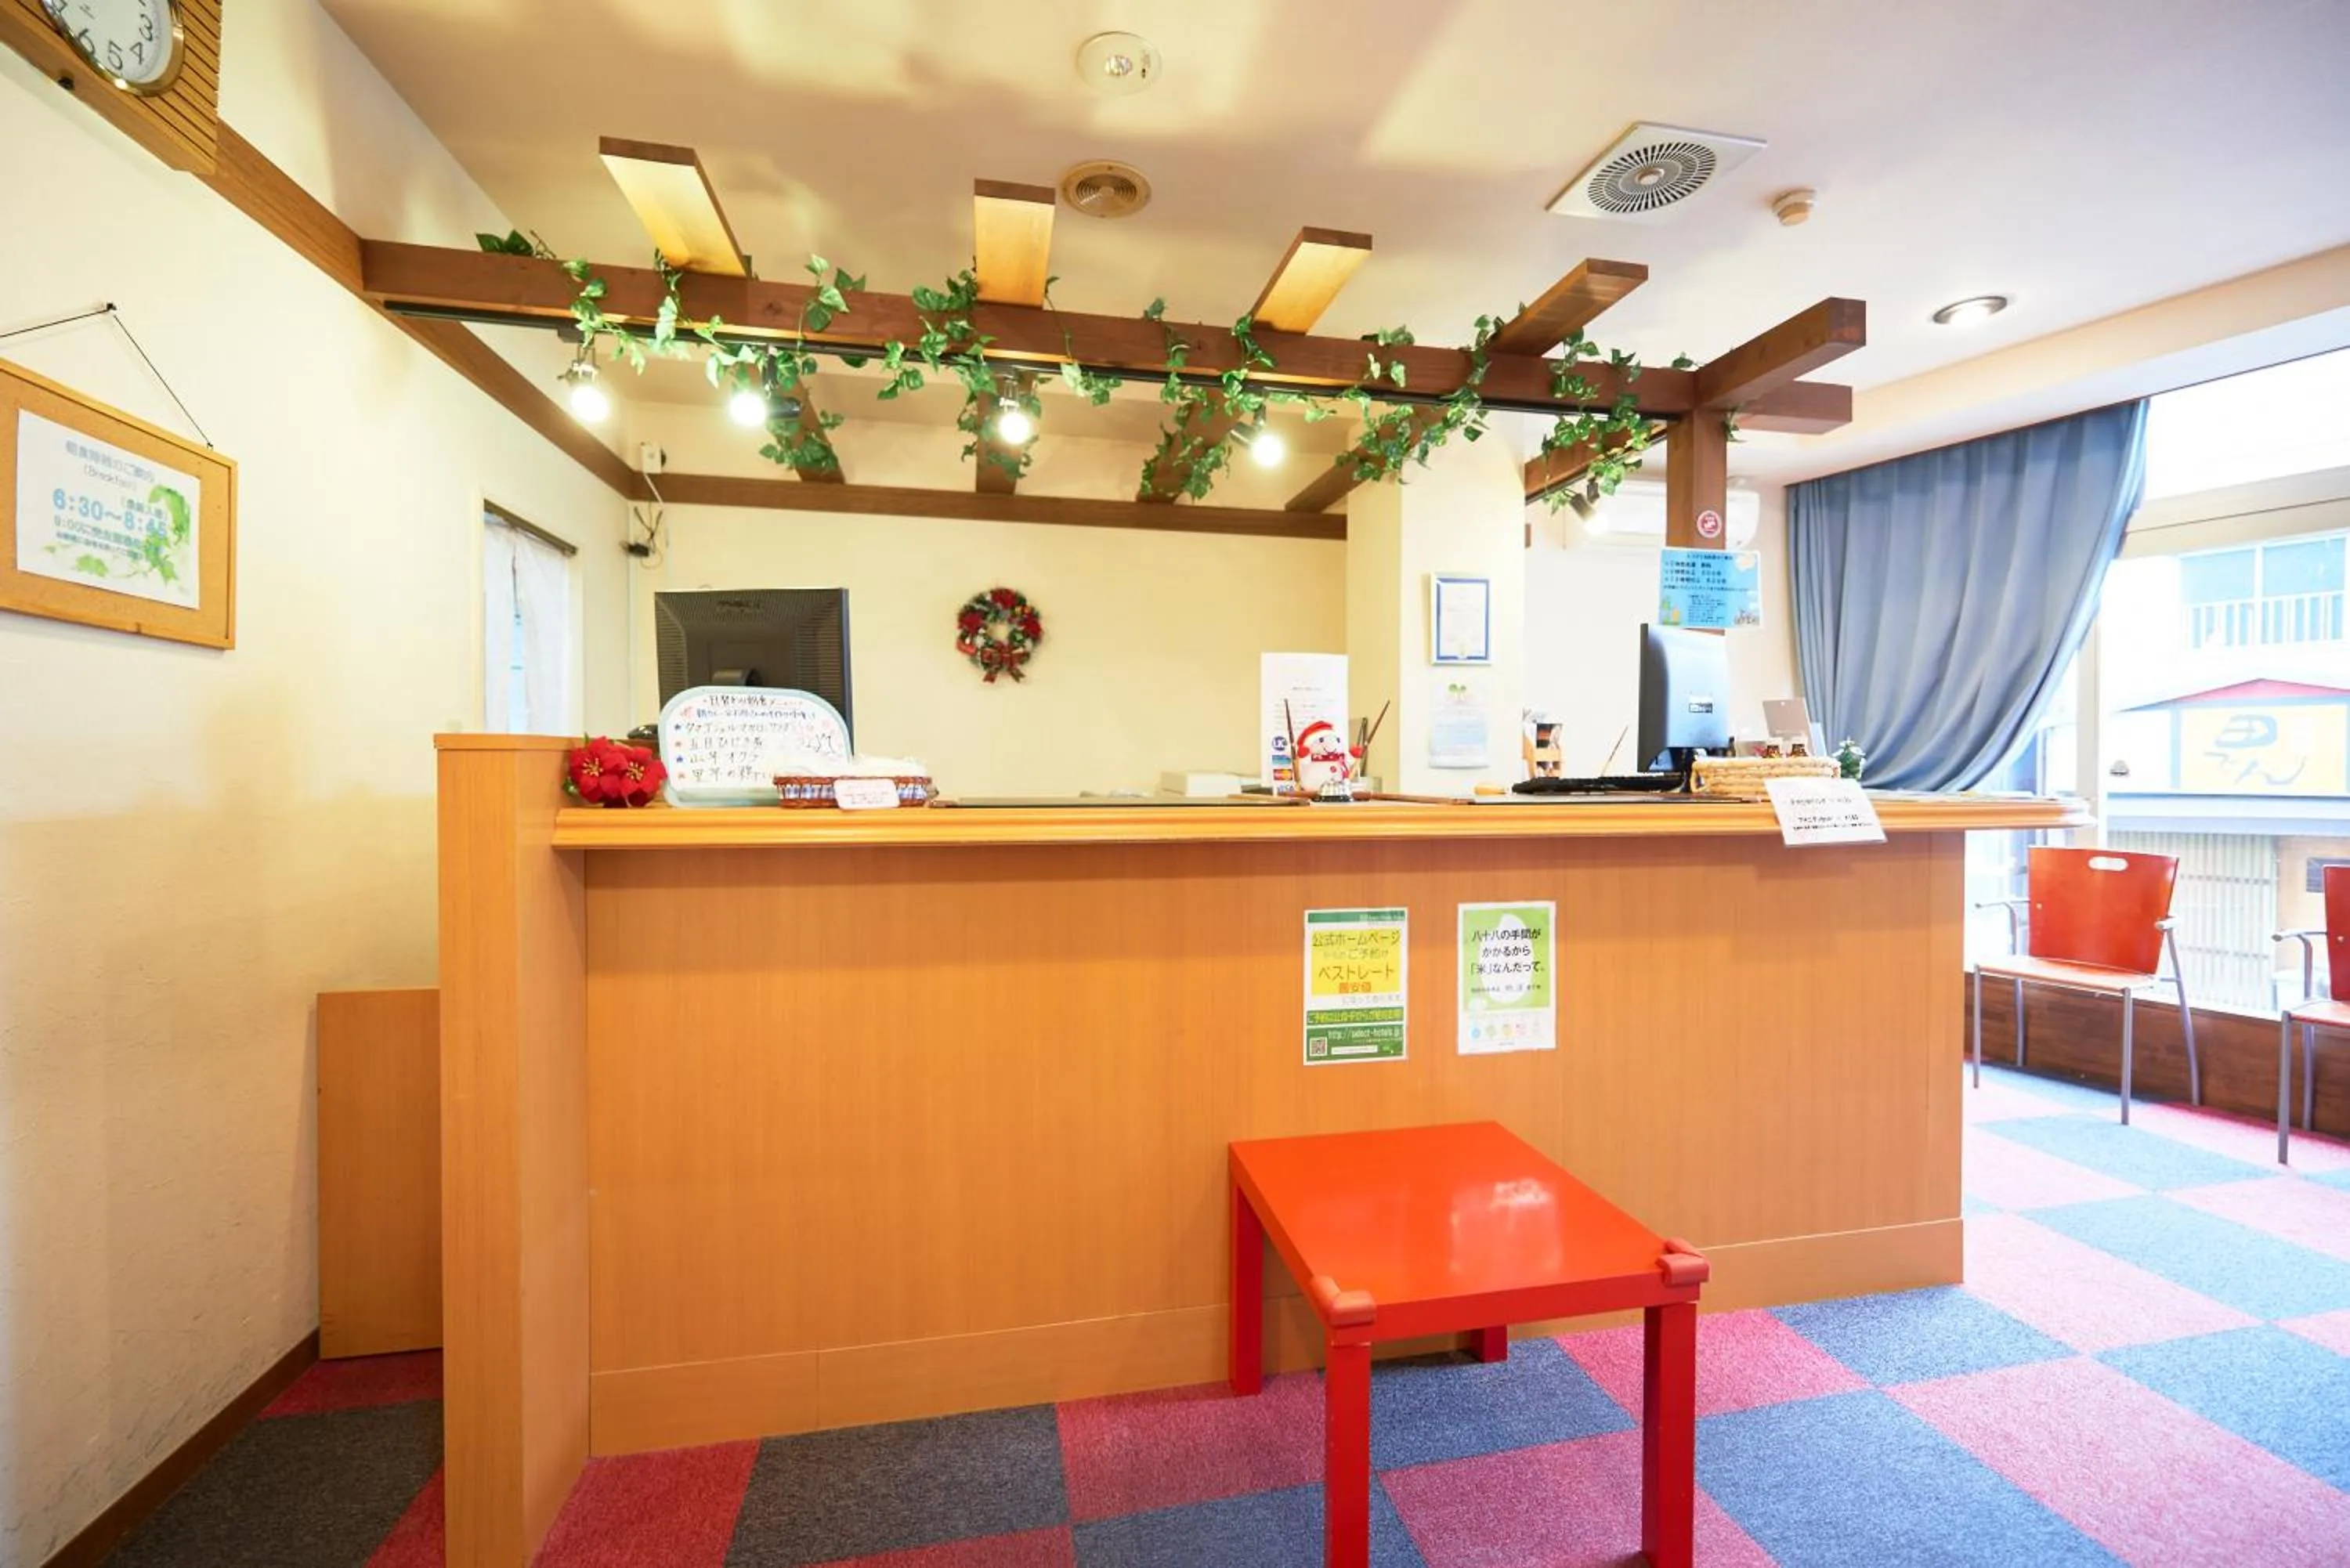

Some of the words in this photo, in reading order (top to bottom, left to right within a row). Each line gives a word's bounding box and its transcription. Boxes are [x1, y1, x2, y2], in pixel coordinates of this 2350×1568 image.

[107, 40, 123, 70] 5
[1313, 929, 1401, 947] 公式ホームページ
[1471, 928, 1542, 943] 八十八の手間が
[1482, 945, 1531, 958] かかるから
[1318, 963, 1394, 981] ベストレート
